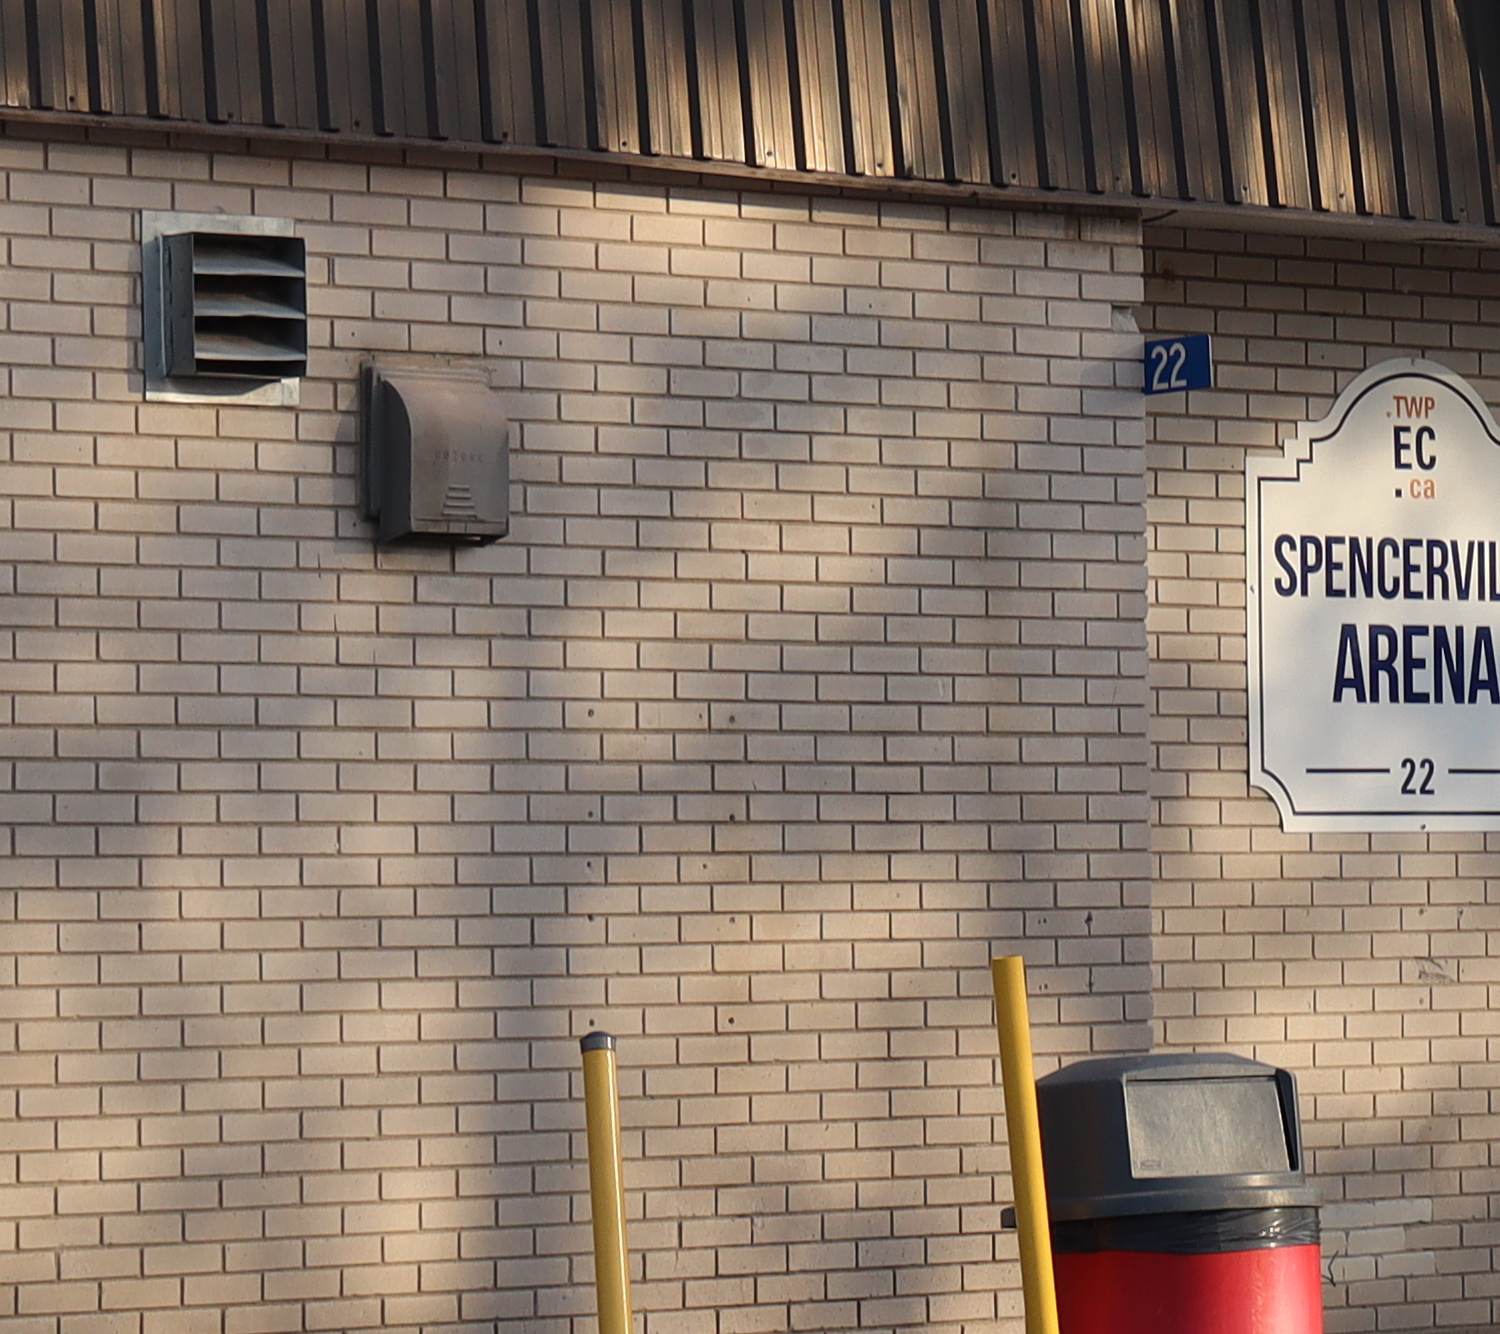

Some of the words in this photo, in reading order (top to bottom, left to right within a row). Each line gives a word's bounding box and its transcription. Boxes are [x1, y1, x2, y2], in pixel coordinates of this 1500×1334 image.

[1150, 342, 1188, 391] 22
[1392, 425, 1438, 470] EC
[1332, 623, 1500, 705] ARENA
[1400, 757, 1435, 795] 22
